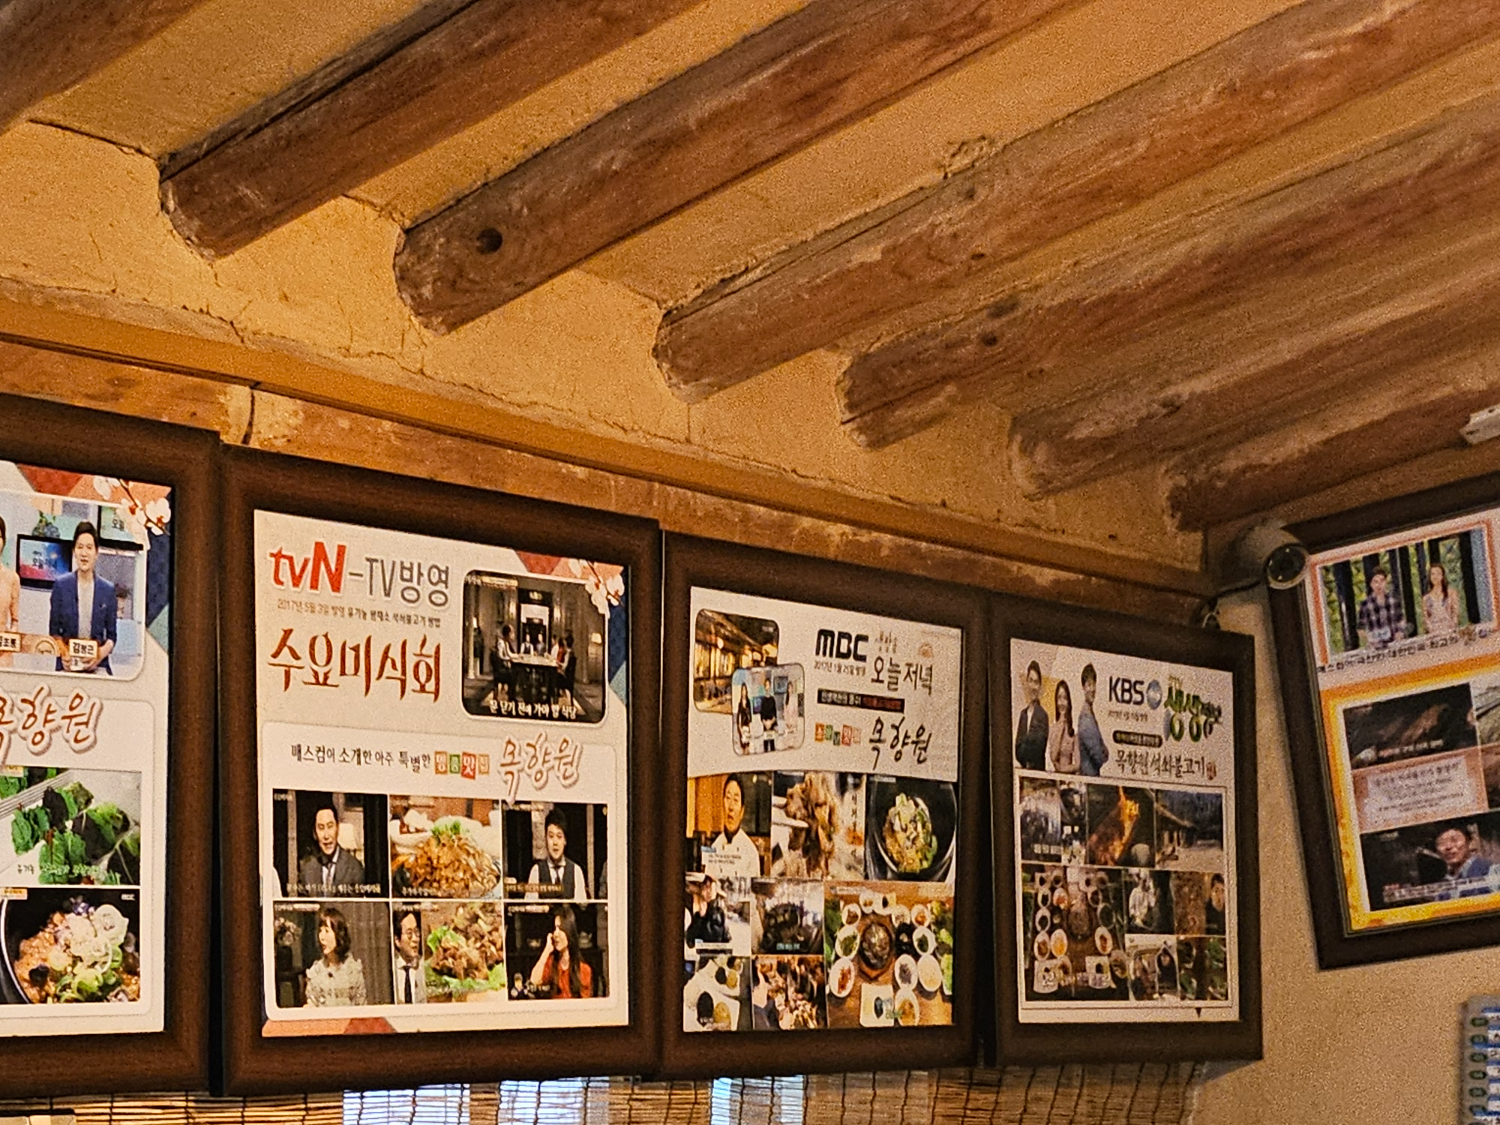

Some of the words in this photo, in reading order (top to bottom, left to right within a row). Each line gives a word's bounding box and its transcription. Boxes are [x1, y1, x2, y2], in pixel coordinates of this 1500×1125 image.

[267, 628, 441, 702] 수요미식회
[815, 629, 869, 663] MBC
[1109, 676, 1145, 706] KBS
[291, 744, 335, 763] 매스컴이
[339, 747, 372, 766] 소개한
[375, 753, 394, 767] 아주
[399, 751, 431, 773] 특별한
[500, 734, 579, 797] 목향원
[869, 716, 932, 770] 목향원
